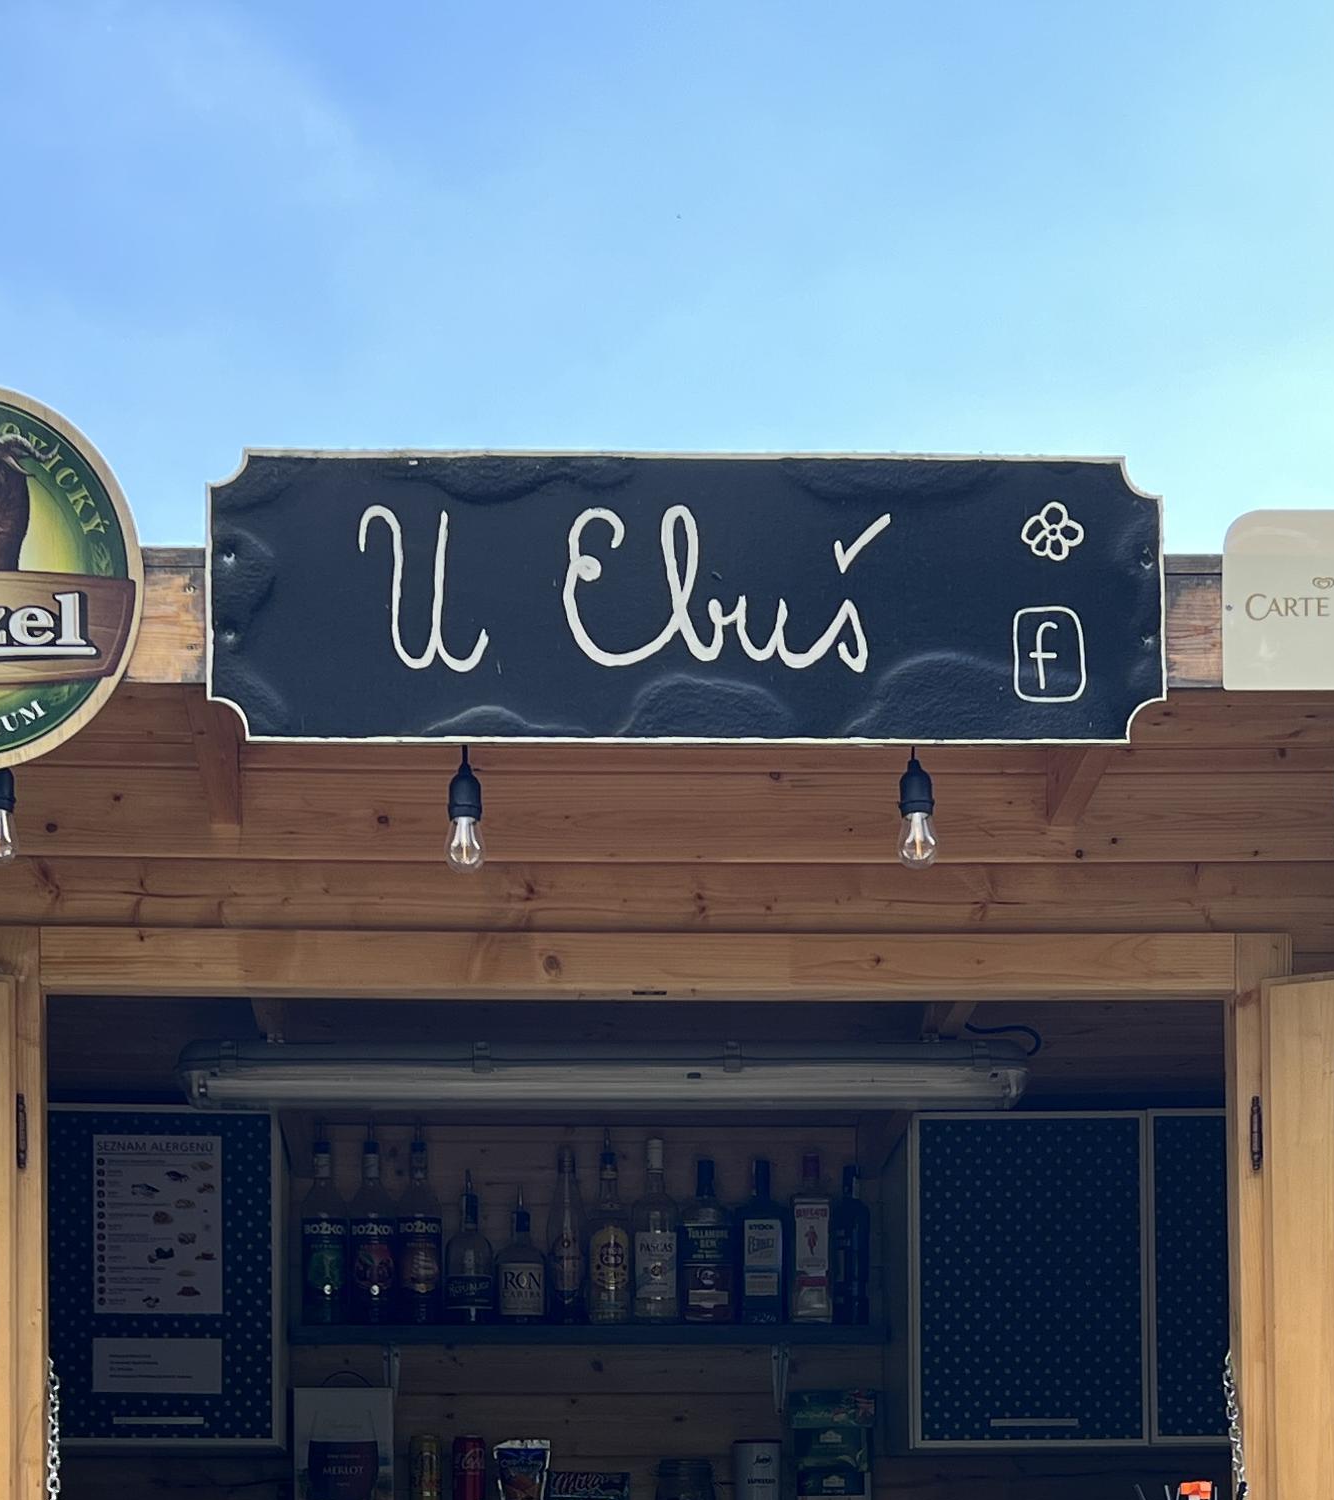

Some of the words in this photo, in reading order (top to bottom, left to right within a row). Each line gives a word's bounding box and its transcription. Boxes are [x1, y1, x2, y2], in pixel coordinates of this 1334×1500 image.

[358, 503, 490, 673] U
[563, 503, 892, 675] Ebuš
[1245, 593, 1331, 622] CARTE
[97, 1141, 147, 1152] SEZNAM
[504, 1271, 542, 1290] RON
[322, 1465, 364, 1476] MERLOT
